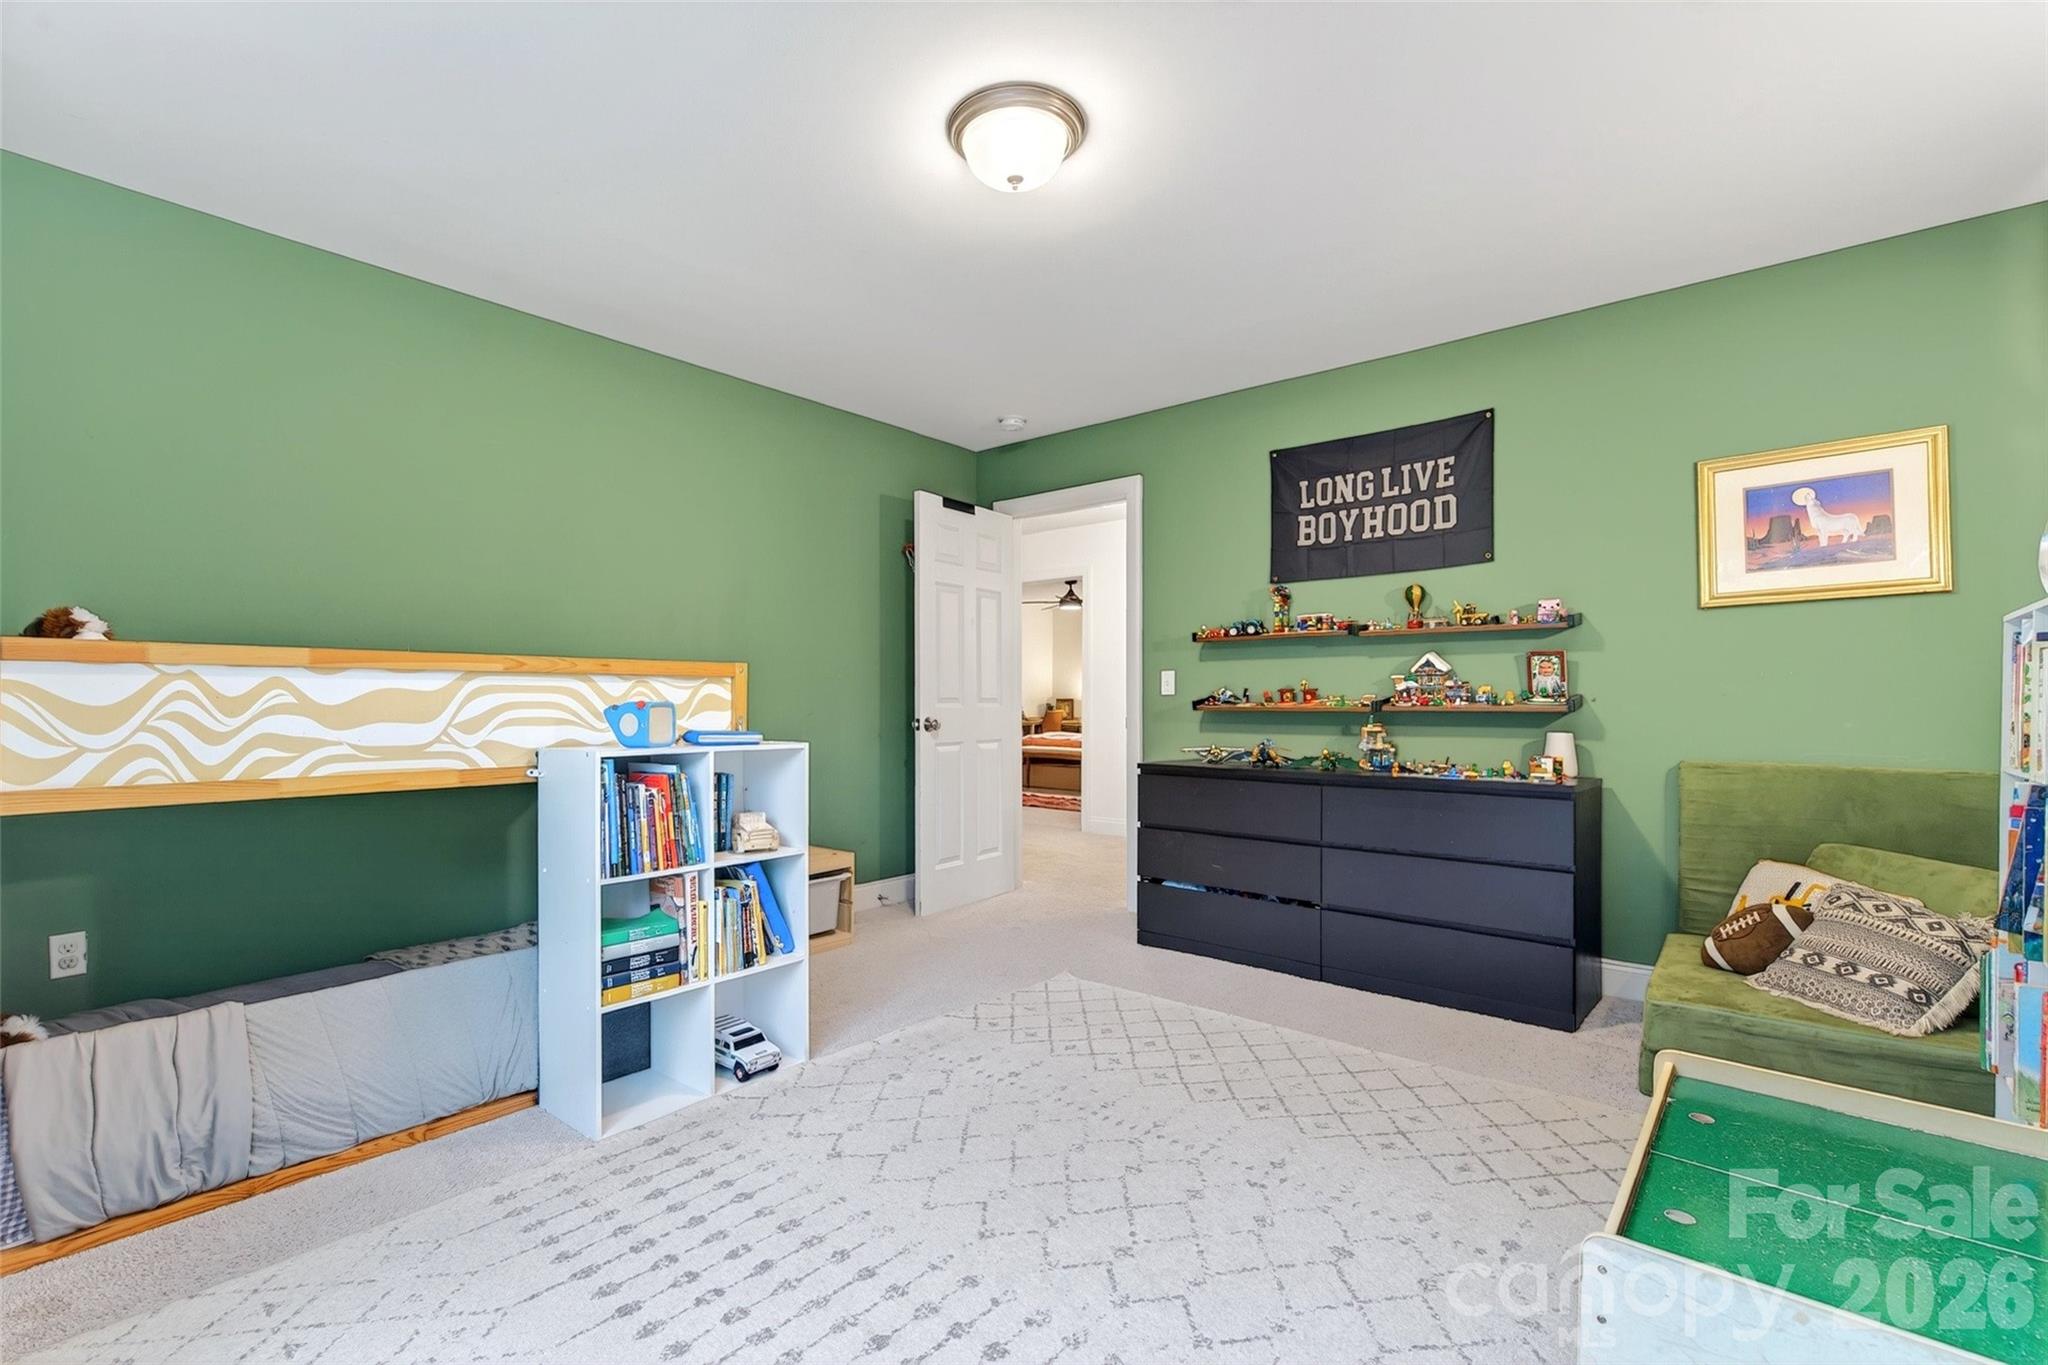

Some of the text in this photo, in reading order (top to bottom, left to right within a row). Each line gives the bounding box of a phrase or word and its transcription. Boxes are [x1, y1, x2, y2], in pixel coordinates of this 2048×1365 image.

[1299, 455, 1455, 509] LONG LIVE
[1297, 493, 1457, 546] BOYHOOD
